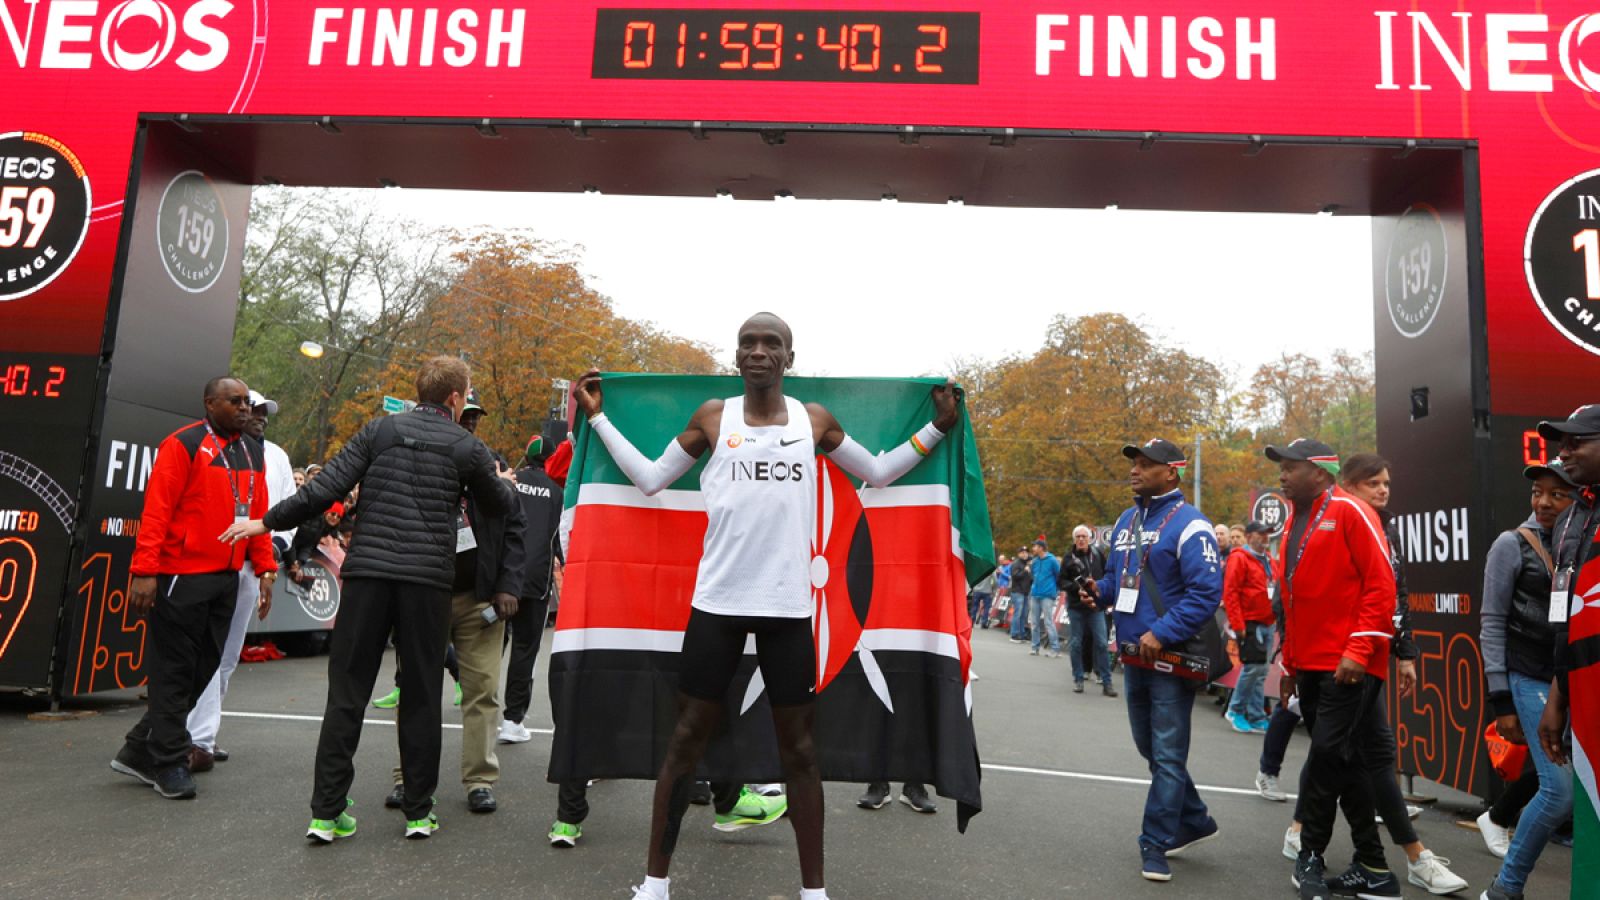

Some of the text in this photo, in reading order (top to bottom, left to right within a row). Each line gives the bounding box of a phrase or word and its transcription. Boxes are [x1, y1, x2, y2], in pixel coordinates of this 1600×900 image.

[308, 7, 527, 68] FINISH
[623, 21, 947, 74] 01:59:40.2
[1035, 13, 1277, 81] FINISH
[0, 156, 56, 180] EOS
[177, 204, 215, 260] 1:59
[0, 245, 58, 283] ENGE
[167, 243, 216, 281] CHALLENGE
[1399, 240, 1432, 301] 1:59
[1396, 283, 1438, 324] CHALLENGE
[515, 482, 551, 498] KENYA
[731, 461, 803, 482] INEOS
[1260, 507, 1281, 525] 1:59
[1200, 536, 1218, 564] LA
